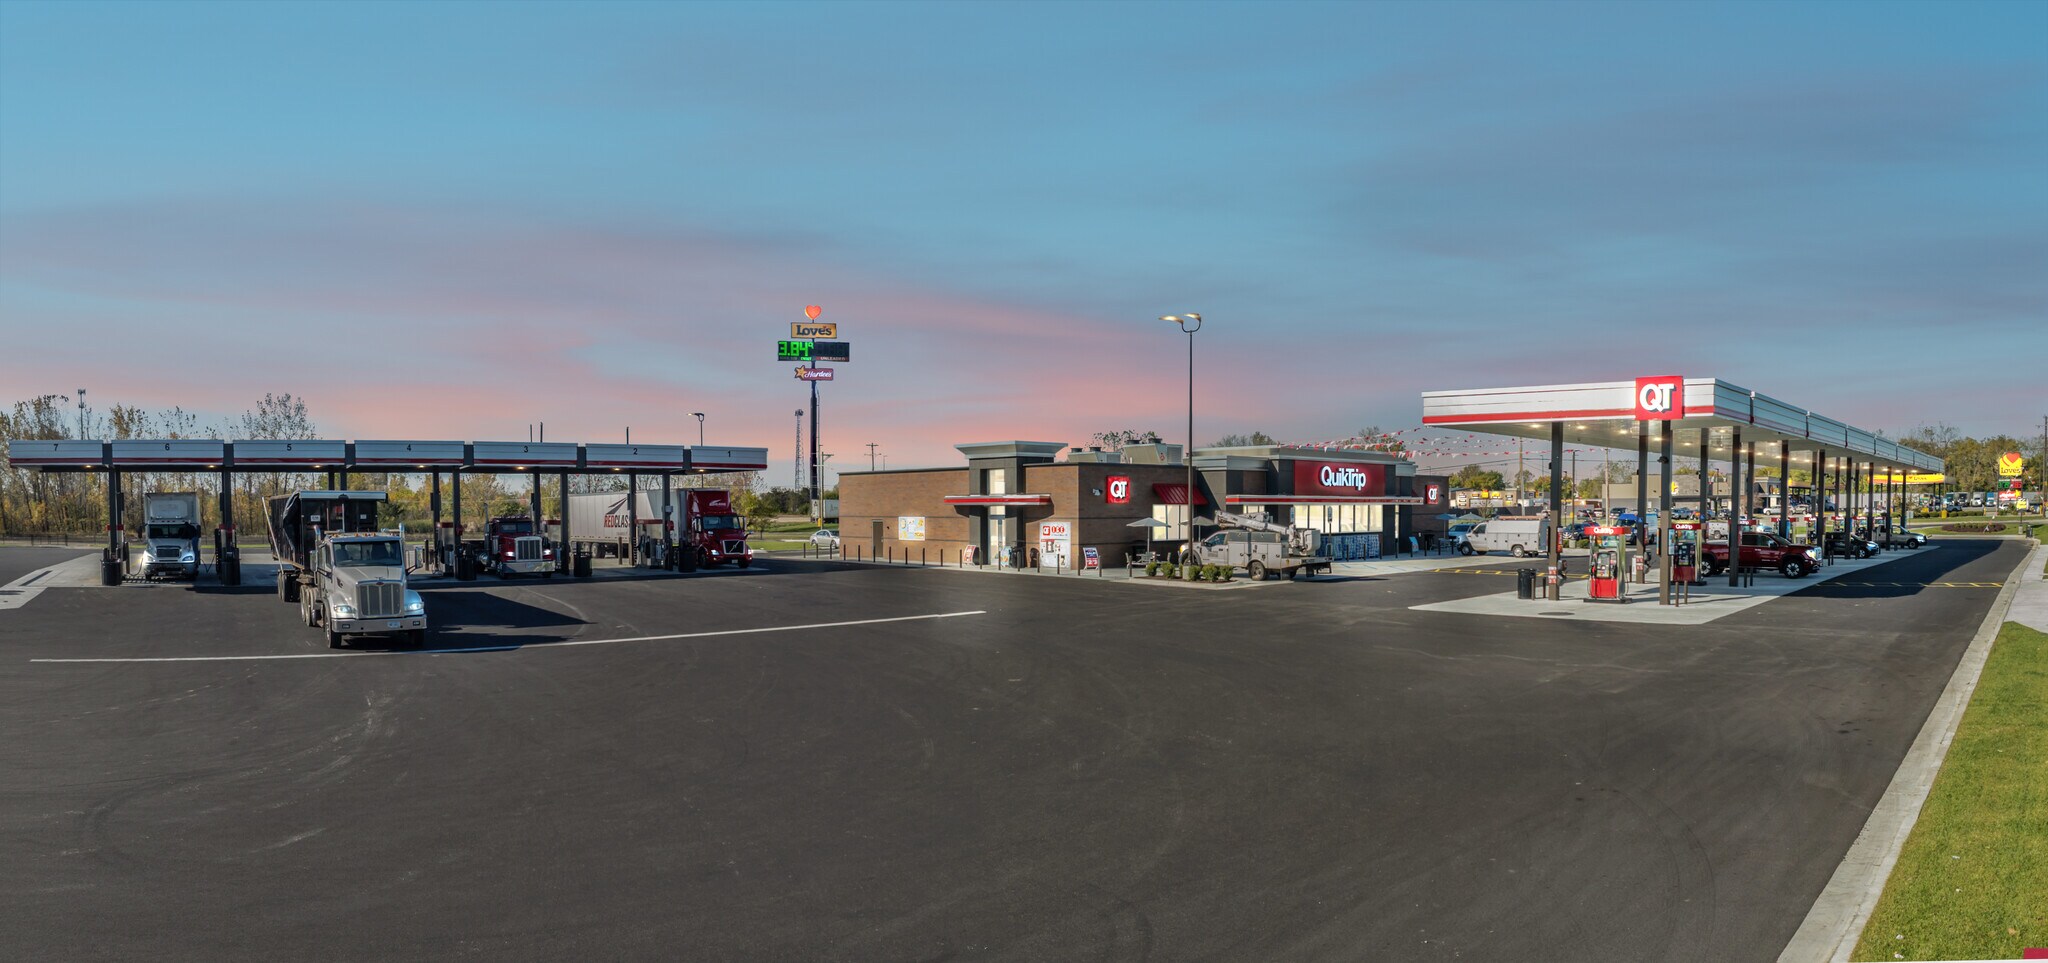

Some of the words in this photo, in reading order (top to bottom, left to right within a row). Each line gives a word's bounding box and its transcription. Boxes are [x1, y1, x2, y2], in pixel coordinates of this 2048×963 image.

[796, 325, 832, 336] Love's
[1639, 383, 1675, 412] QT
[53, 443, 59, 452] 7
[165, 443, 170, 452] 6
[286, 443, 292, 452] 5
[406, 444, 412, 452] 4
[523, 445, 529, 454] 3
[632, 447, 638, 456] 2
[727, 450, 731, 458] 1
[1321, 466, 1366, 491] QuikTrip
[1110, 480, 1128, 499] QT
[1428, 488, 1437, 500] QT
[604, 515, 630, 528] REDCLAS
